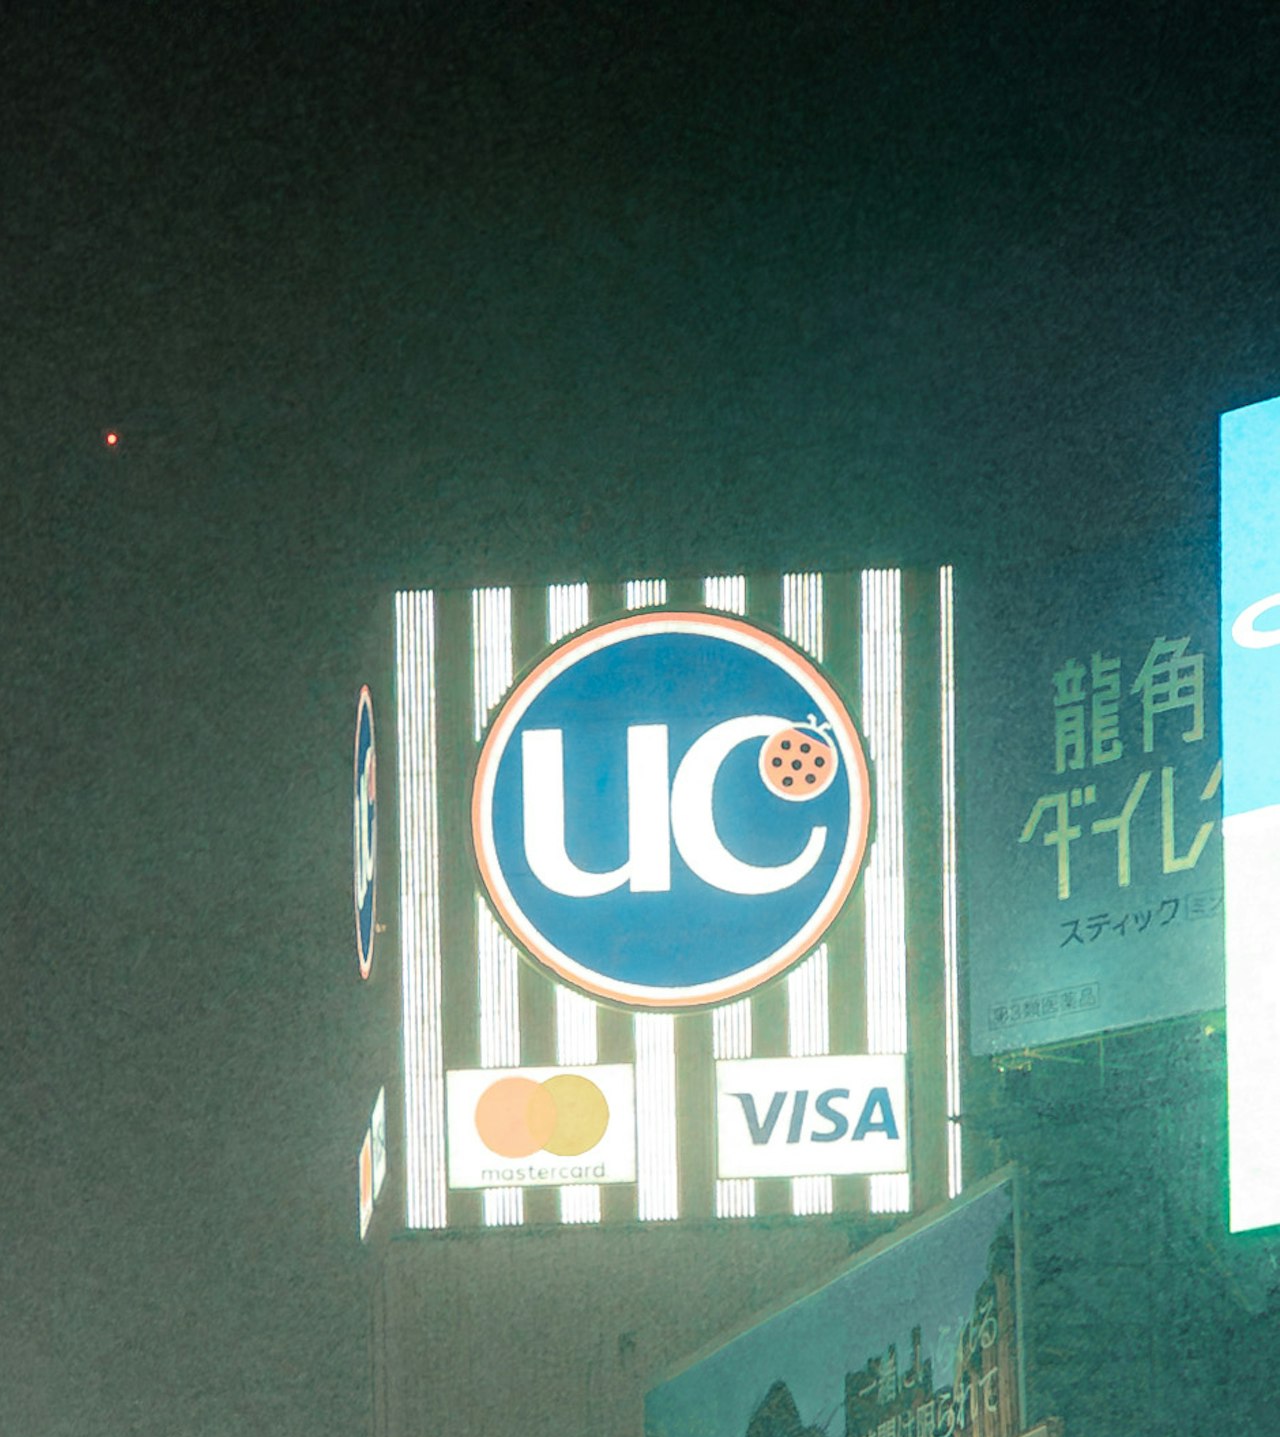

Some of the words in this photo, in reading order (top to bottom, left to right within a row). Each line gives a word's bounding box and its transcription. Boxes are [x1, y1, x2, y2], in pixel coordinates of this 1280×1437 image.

[1060, 899, 1179, 949] スティック
[725, 1086, 899, 1146] VISA
[481, 1161, 607, 1182] mastercard
